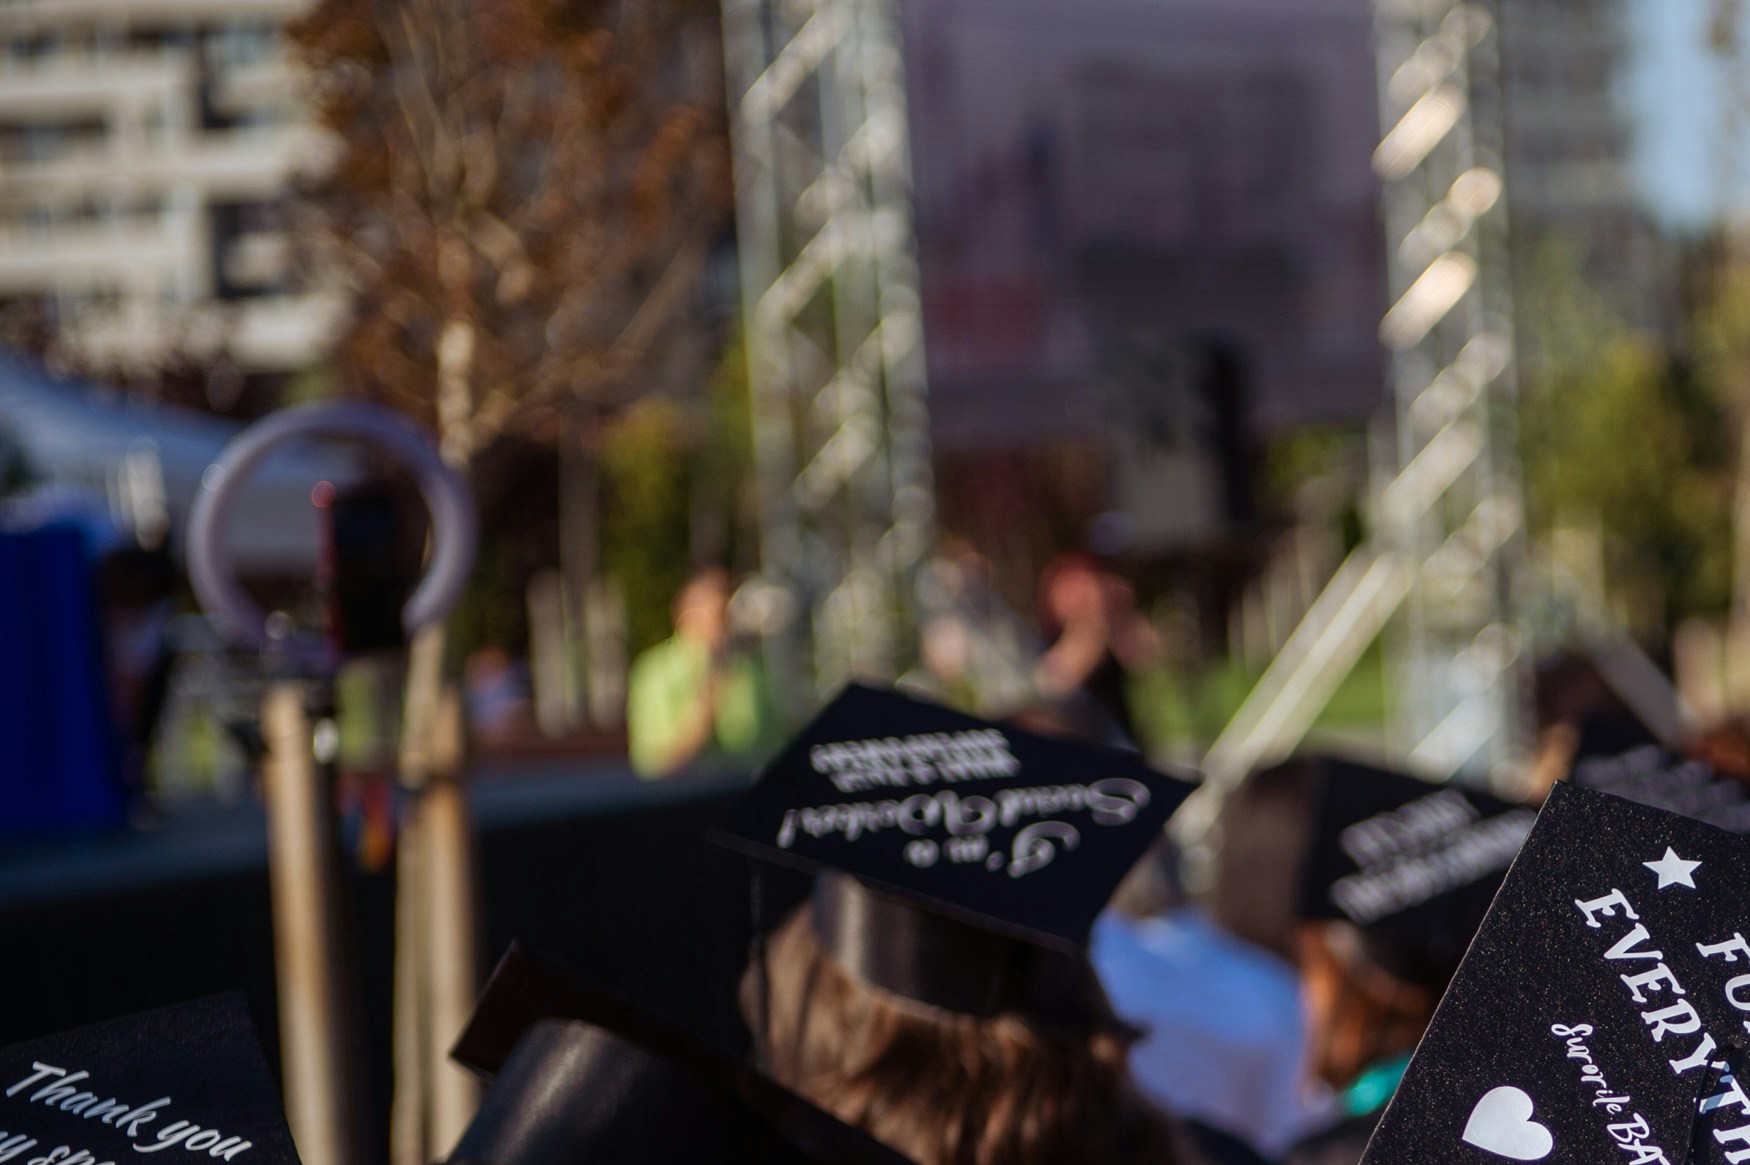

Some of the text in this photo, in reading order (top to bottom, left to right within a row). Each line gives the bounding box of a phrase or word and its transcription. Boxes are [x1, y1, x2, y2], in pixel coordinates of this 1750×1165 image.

[7, 1061, 252, 1162] Thank you
[0, 1131, 38, 1164] y
